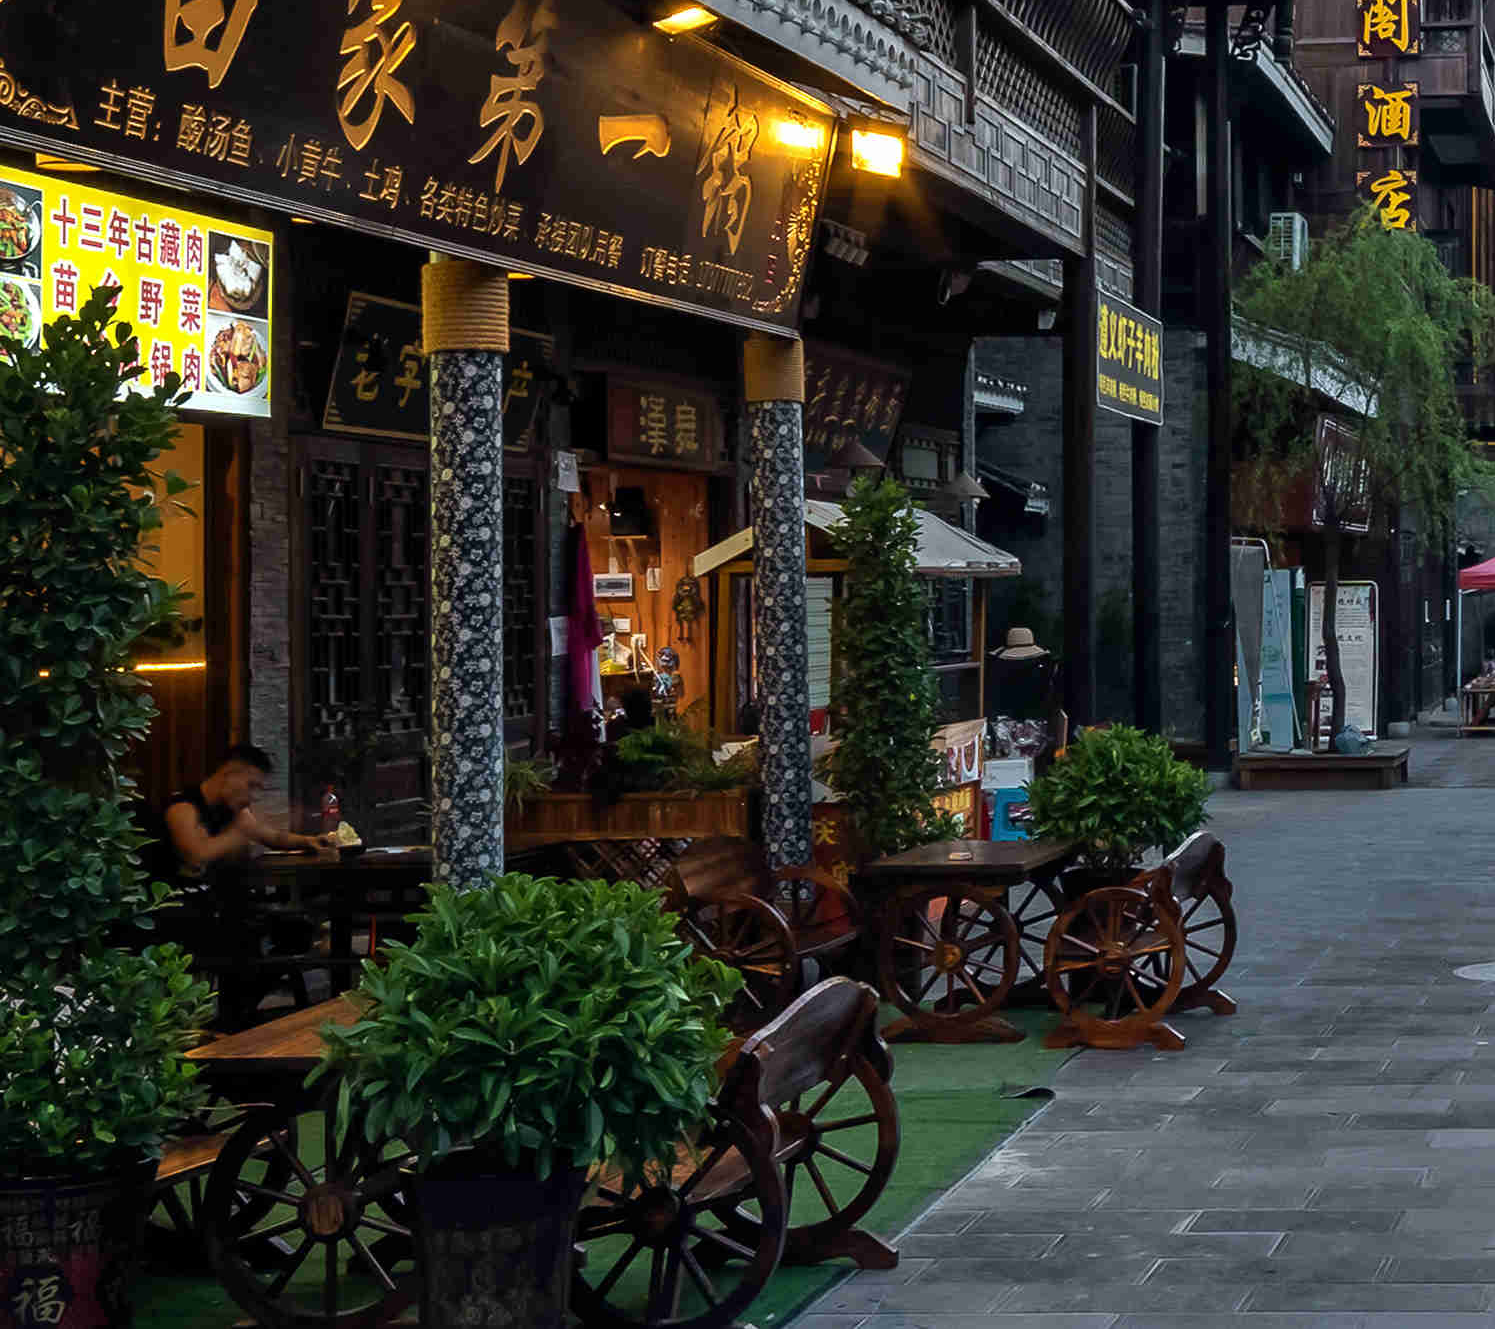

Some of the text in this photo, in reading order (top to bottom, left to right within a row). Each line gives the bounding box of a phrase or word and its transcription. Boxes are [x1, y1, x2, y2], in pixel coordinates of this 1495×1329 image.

[52, 197, 205, 274] 十三年古藏肉
[11, 1275, 66, 1325] 福
